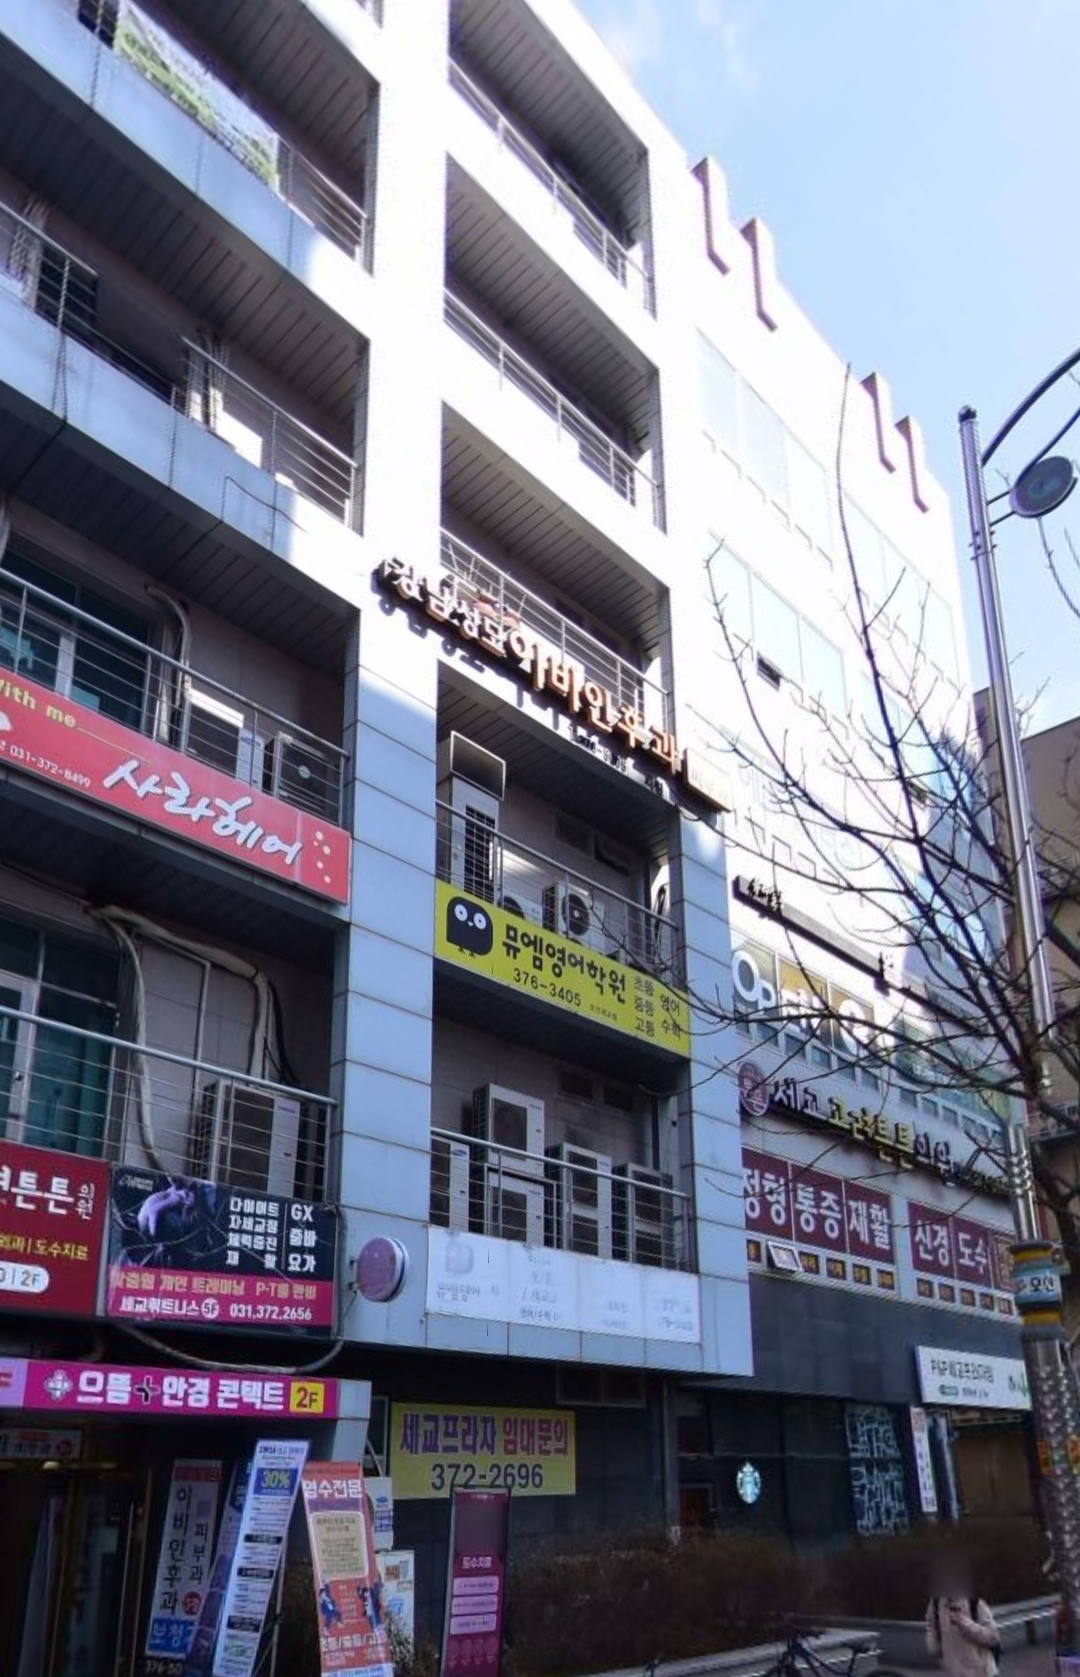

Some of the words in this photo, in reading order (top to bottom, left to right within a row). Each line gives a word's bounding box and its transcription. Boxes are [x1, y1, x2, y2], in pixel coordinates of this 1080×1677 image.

[46, 704, 77, 727] me
[103, 760, 303, 866] 사라헤어
[502, 924, 626, 1004] 뮤엠영어학원
[513, 968, 582, 1008] 376-3405
[229, 1196, 280, 1217] 다이어트
[290, 1203, 314, 1222] GX
[795, 1183, 843, 1239] 통증
[33, 1238, 89, 1262] 도수치료
[915, 1219, 950, 1267] 신경
[288, 1253, 317, 1272] 요가
[20, 1269, 42, 1287] 2F
[192, 1276, 245, 1298] 트레이닝
[229, 1302, 313, 1321] 031.372.2656
[295, 1386, 319, 1411] 2F
[401, 1412, 497, 1456] 세교프라자
[503, 1416, 568, 1456] 임대문의
[430, 1463, 543, 1491] 372-2696
[160, 1485, 192, 1616] 이비인후과
[189, 1521, 208, 1584] 피부과
